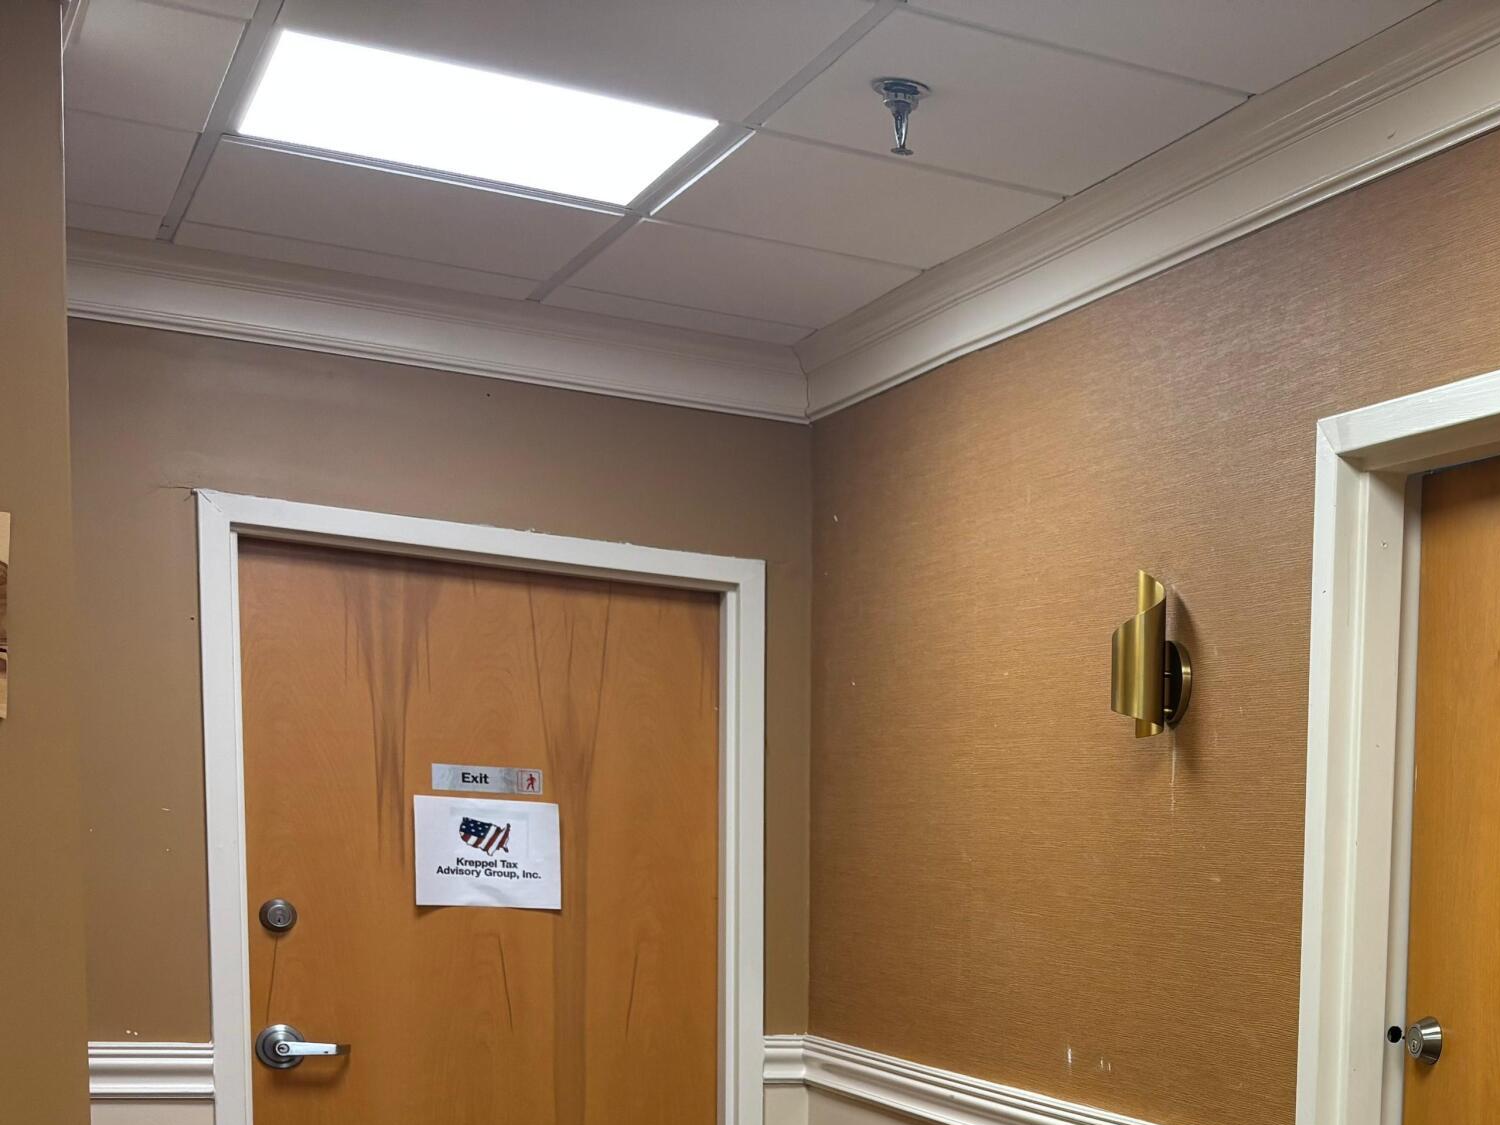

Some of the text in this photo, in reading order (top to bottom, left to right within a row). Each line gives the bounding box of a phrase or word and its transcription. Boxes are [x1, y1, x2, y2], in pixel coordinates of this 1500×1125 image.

[461, 772, 490, 785] Exit
[456, 857, 518, 871] Kreppel Tax
[436, 865, 542, 880] Advisory Group, Inc.
